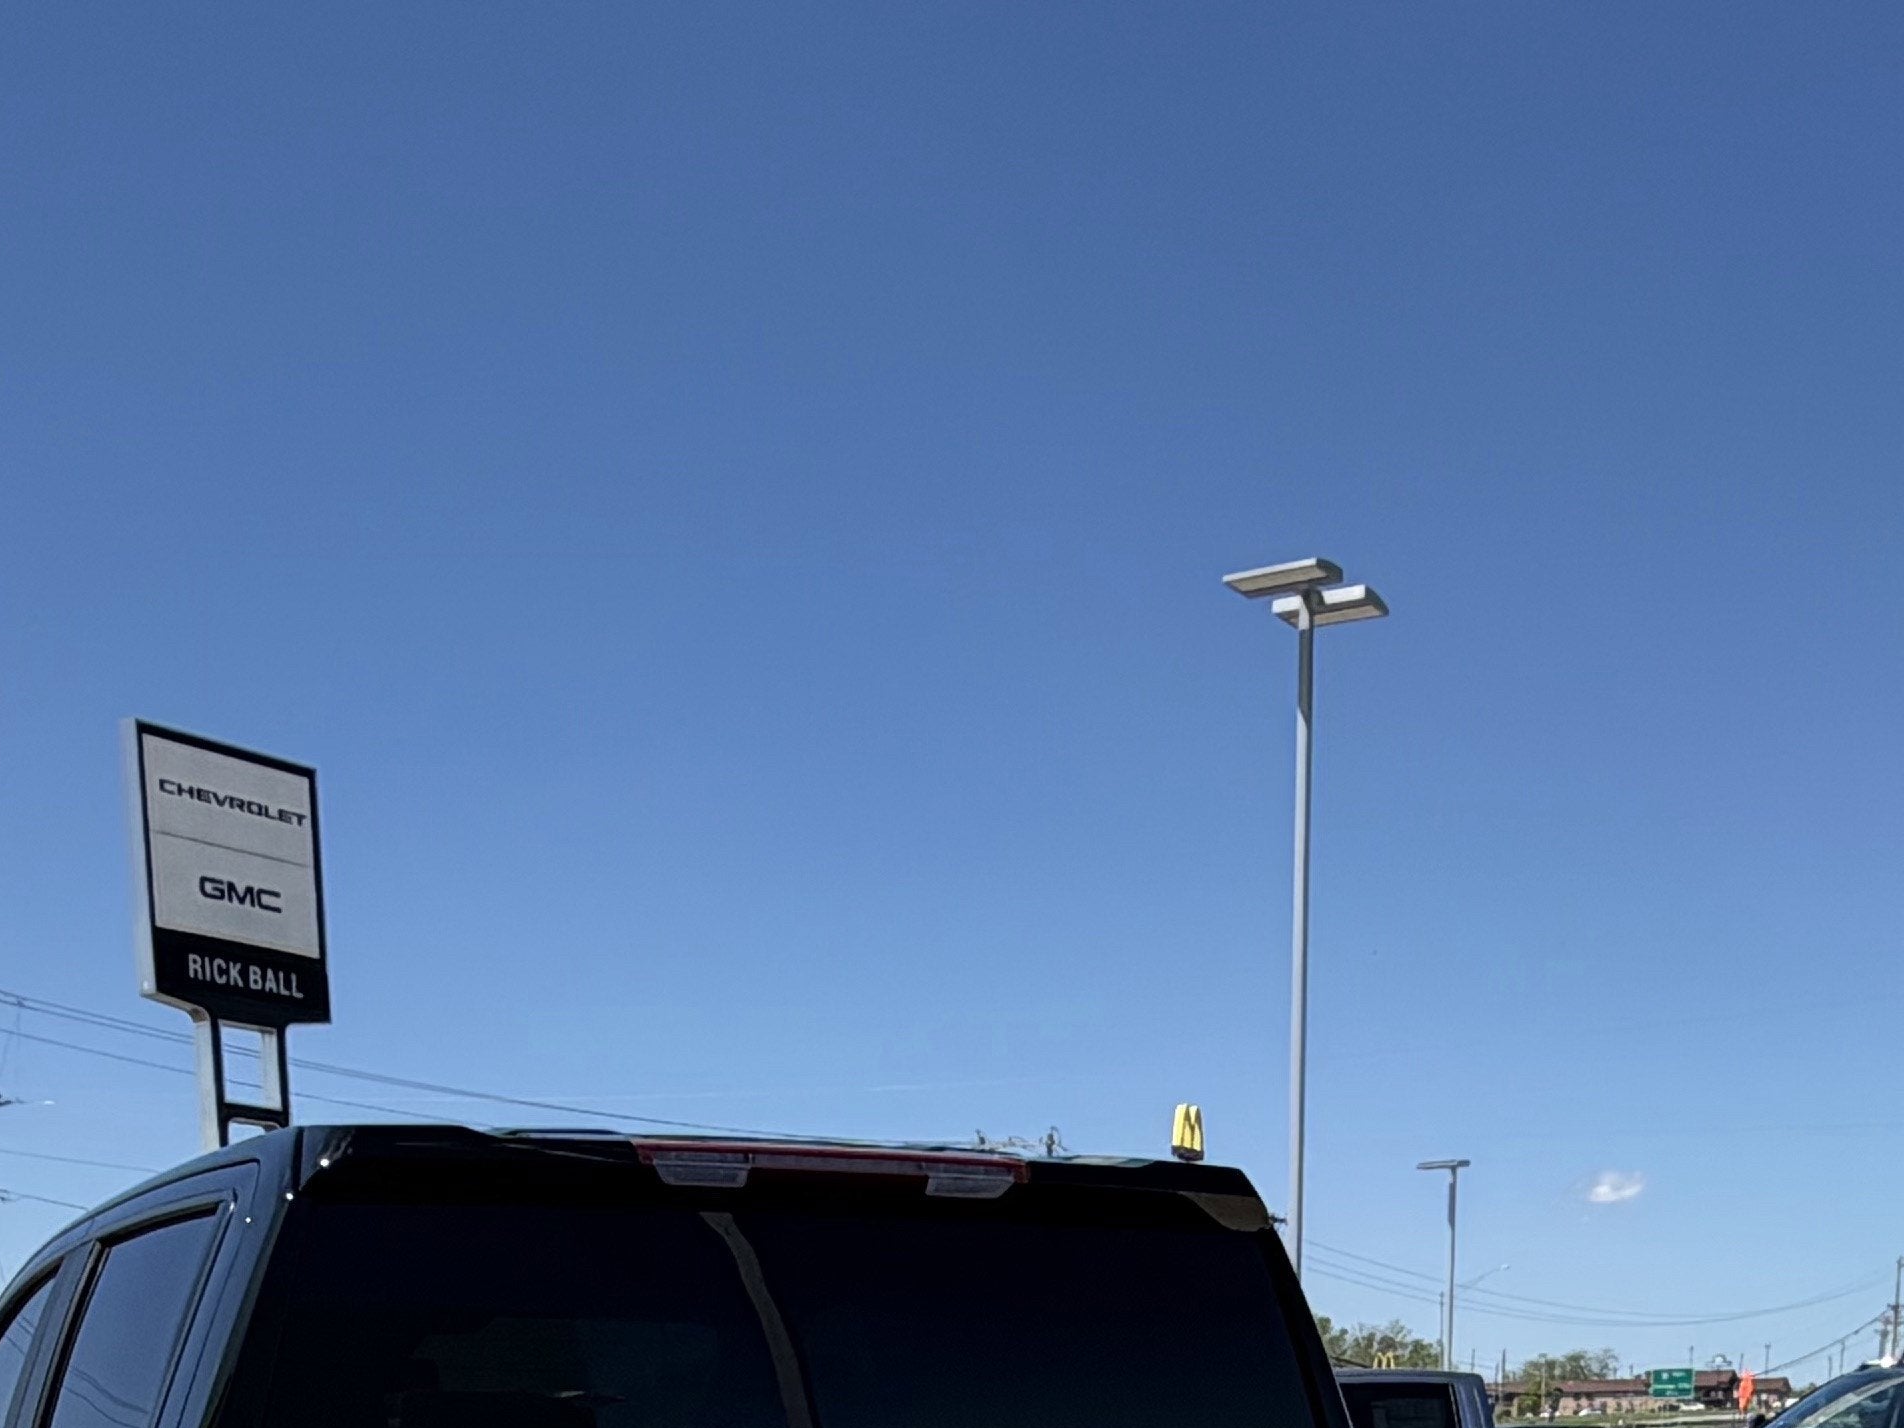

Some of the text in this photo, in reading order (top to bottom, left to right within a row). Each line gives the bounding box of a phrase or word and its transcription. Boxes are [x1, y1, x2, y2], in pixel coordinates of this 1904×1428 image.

[158, 778, 308, 827] CHEVROLET
[198, 875, 282, 914] GMC
[187, 953, 304, 999] RICK BALL
